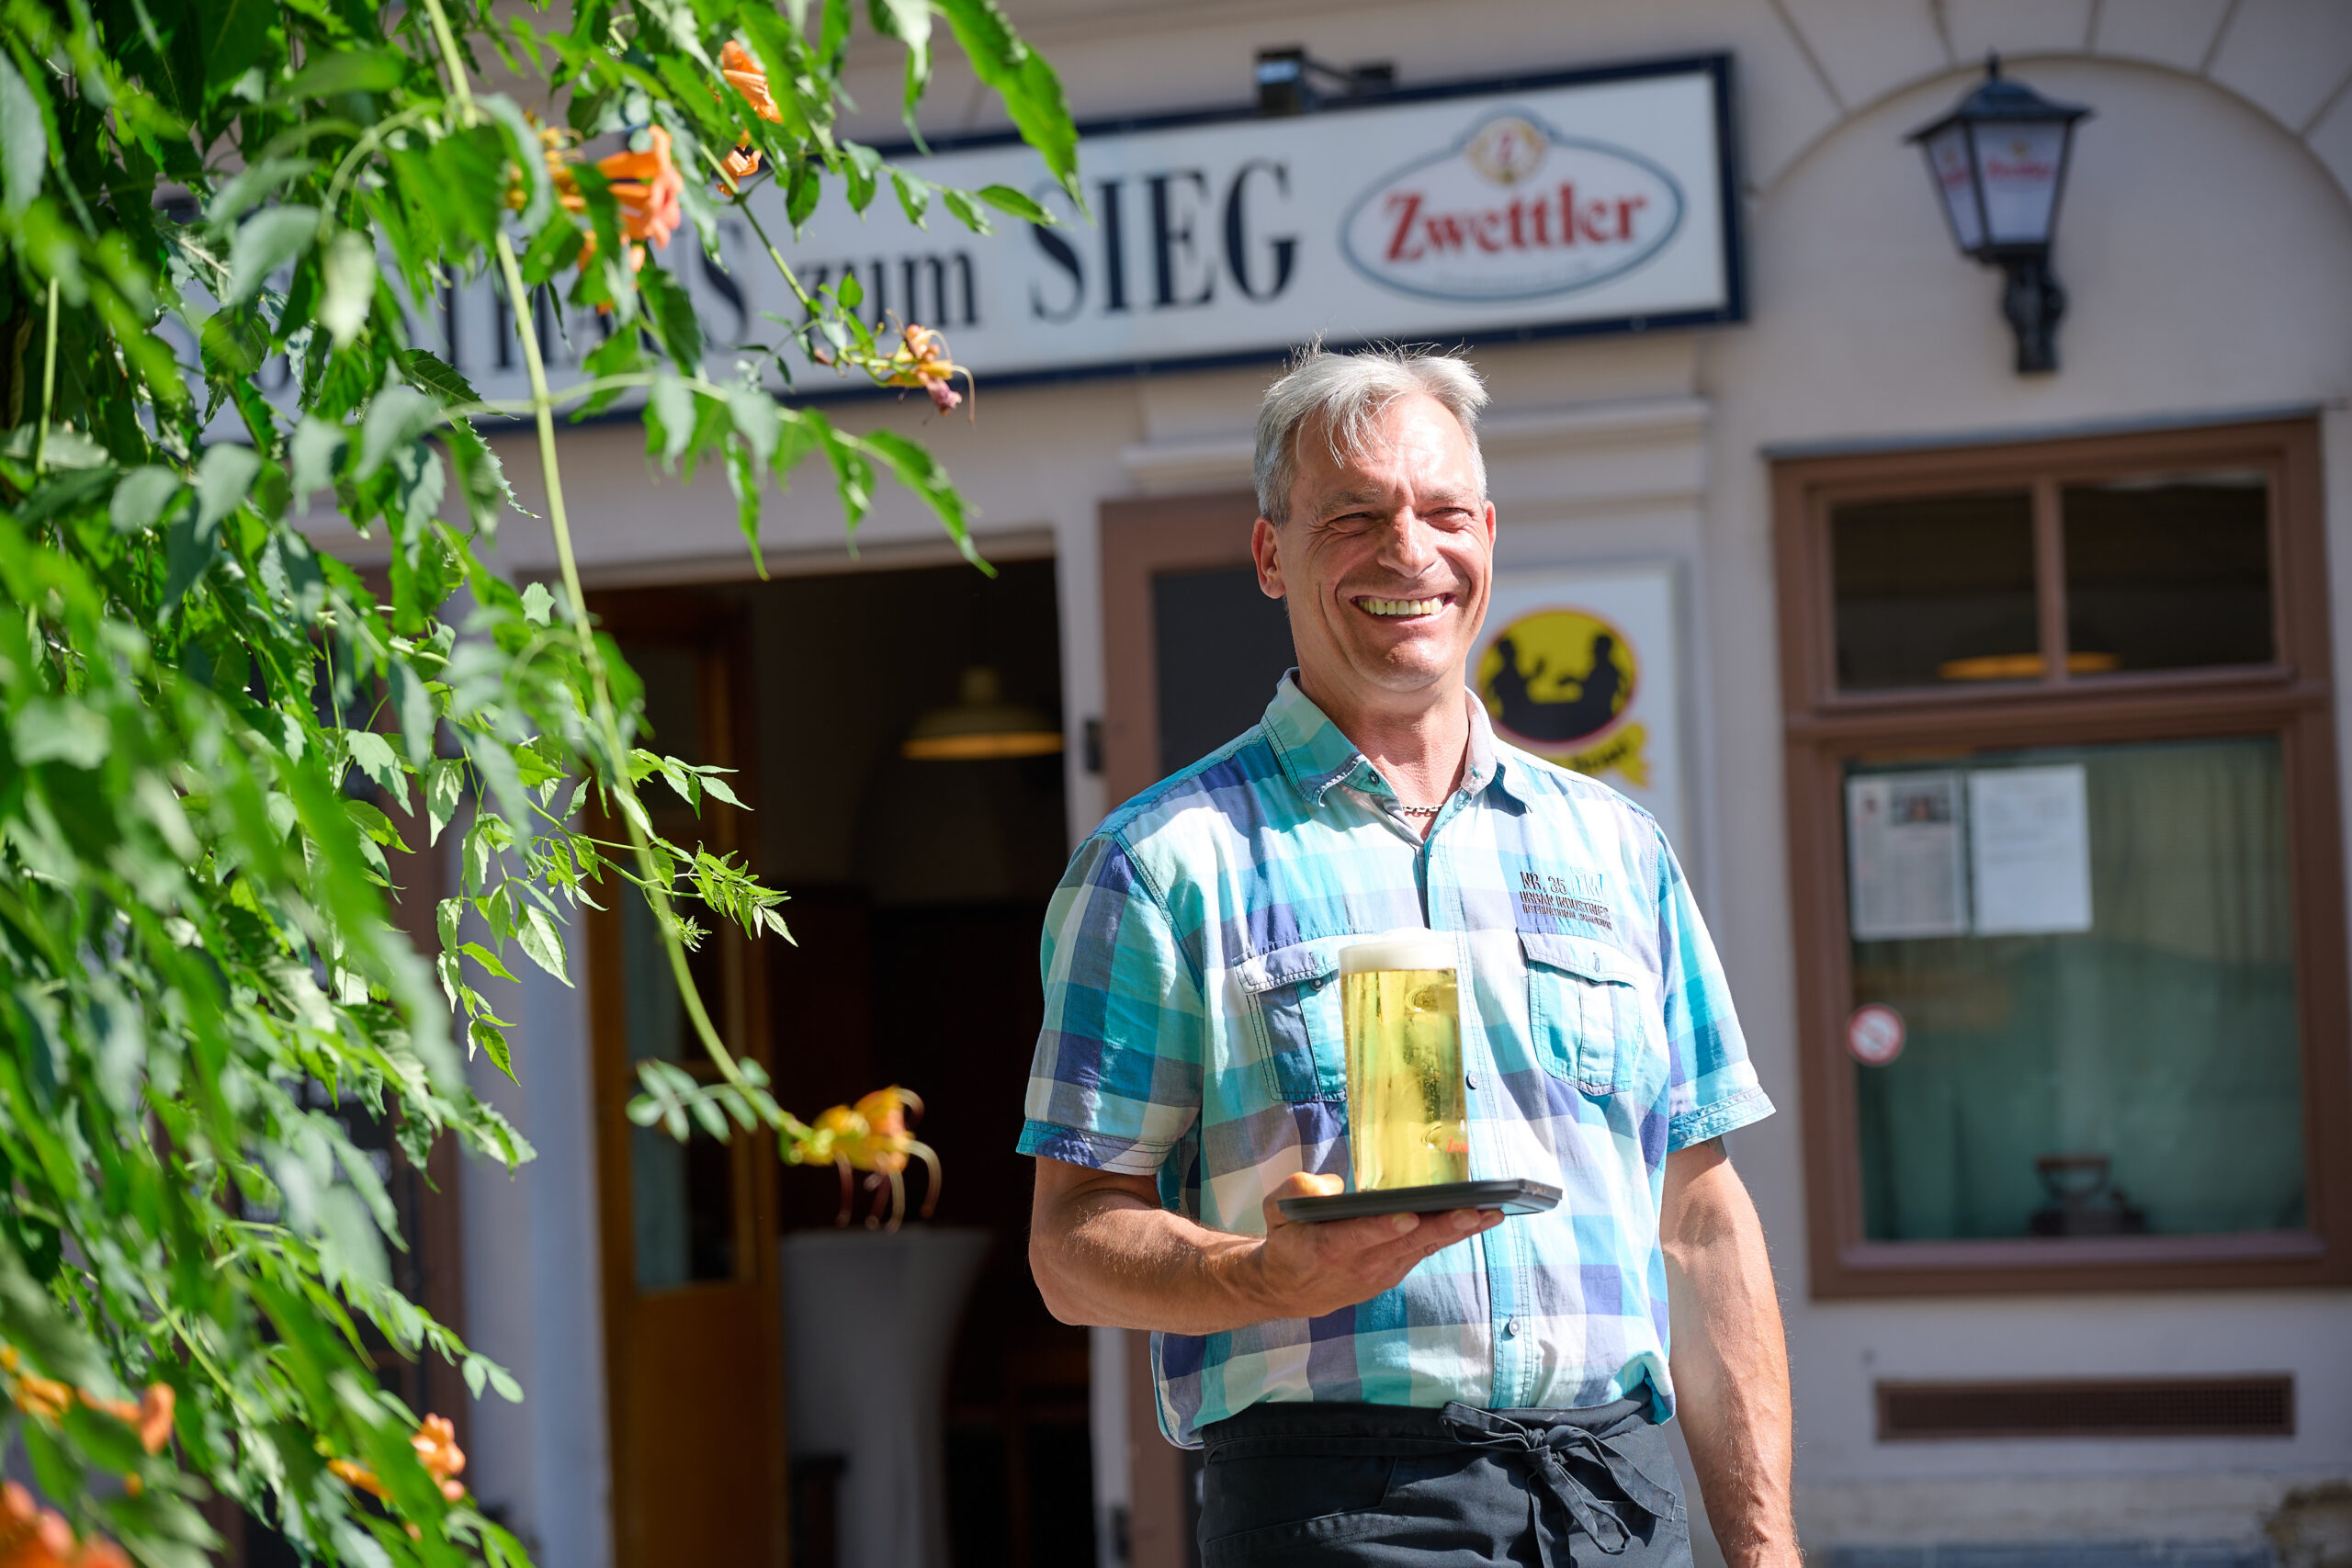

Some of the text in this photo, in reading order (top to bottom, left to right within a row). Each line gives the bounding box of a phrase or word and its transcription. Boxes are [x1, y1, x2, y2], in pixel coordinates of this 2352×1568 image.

[1385, 182, 1647, 262] Zwettler
[797, 251, 979, 340] zum
[1028, 158, 1300, 323] SIEG
[1548, 875, 1567, 895] 35
[1556, 895, 1610, 919] INDUSTRIES
